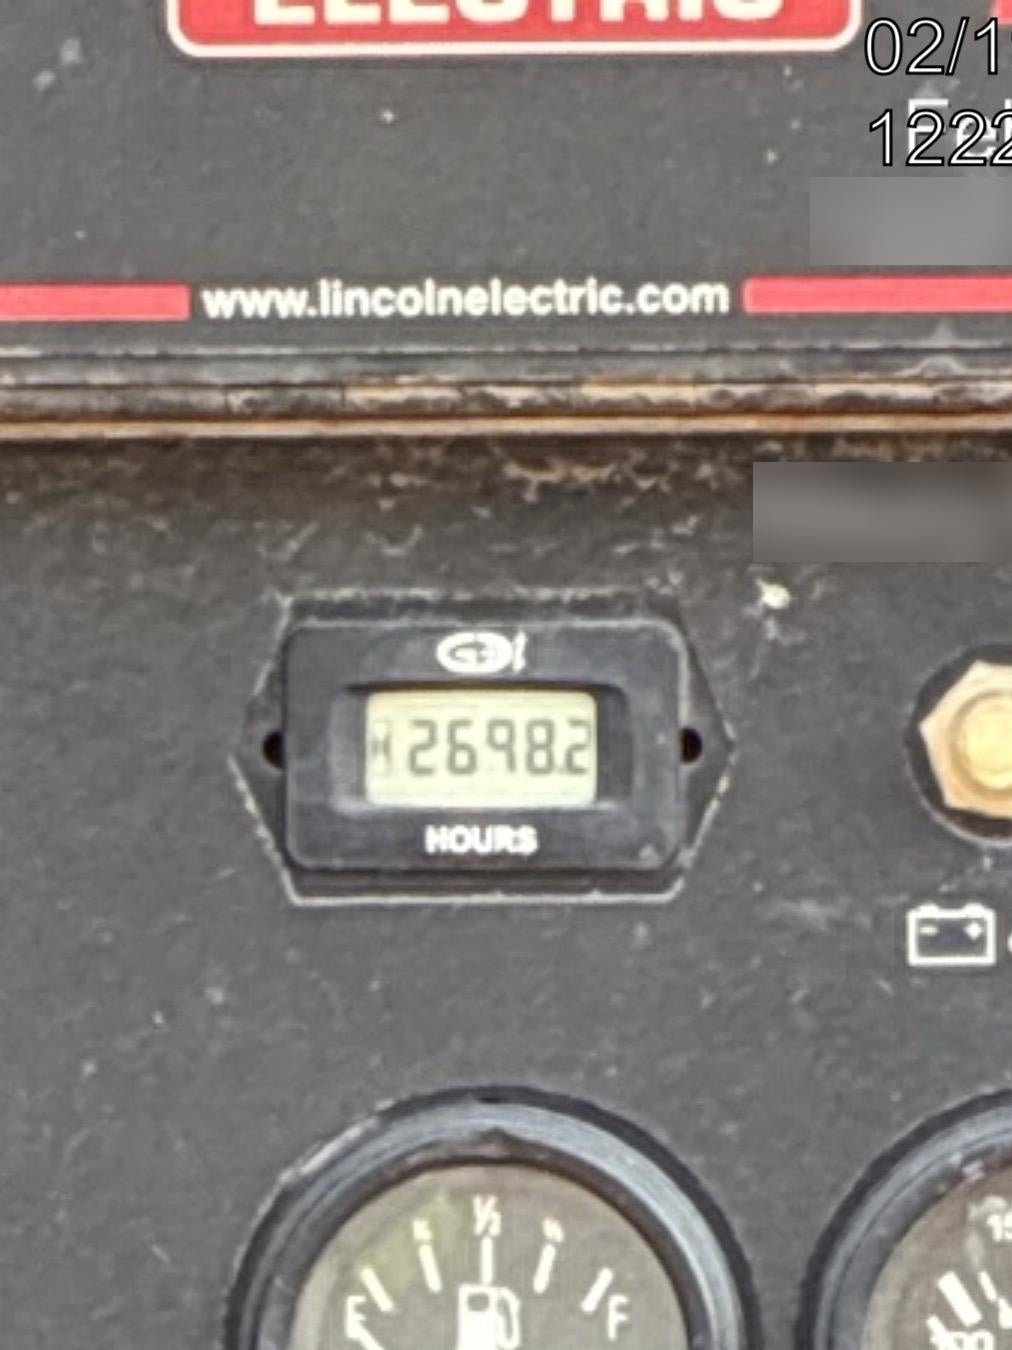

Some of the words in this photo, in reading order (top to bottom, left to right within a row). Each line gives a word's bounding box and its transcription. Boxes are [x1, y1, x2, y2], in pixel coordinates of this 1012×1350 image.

[201, 277, 730, 319] www.lincolnelectric.com
[423, 823, 541, 857] HOURS
[607, 1293, 631, 1341] F
